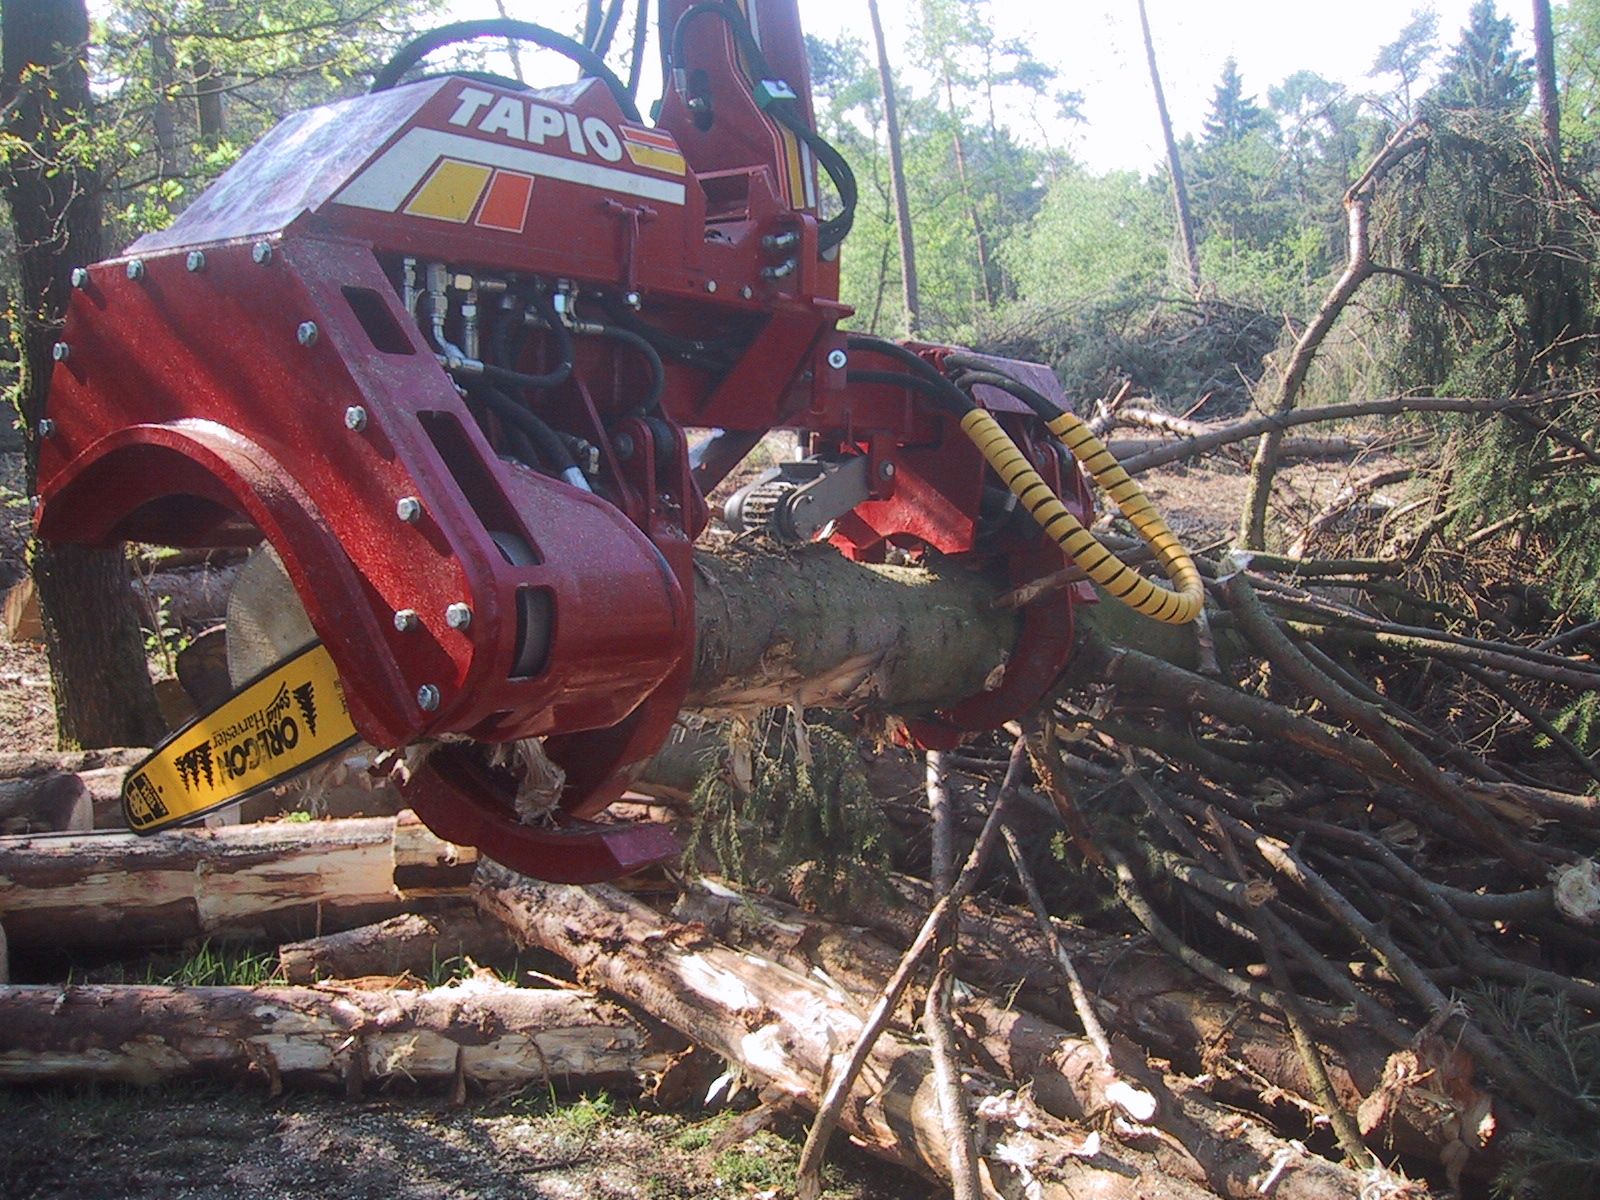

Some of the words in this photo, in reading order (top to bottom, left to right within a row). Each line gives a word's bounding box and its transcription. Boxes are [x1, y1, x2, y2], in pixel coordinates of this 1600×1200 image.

[448, 86, 623, 162] TAPIO
[212, 709, 268, 749] Harvester
[217, 716, 299, 782] OREGON
